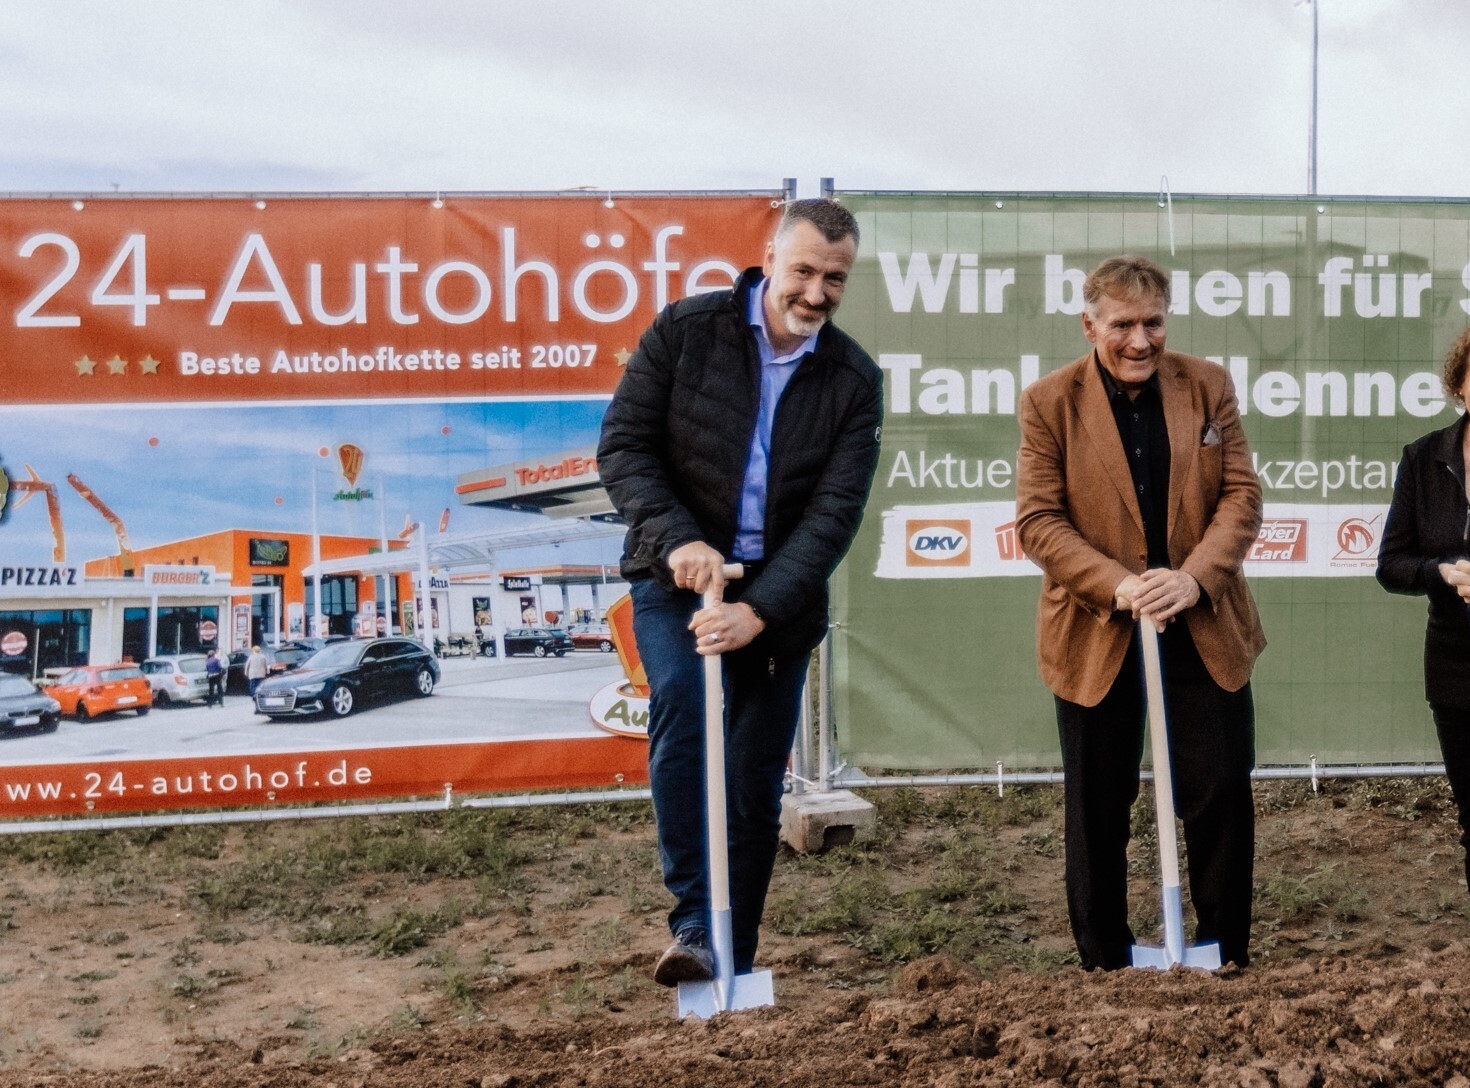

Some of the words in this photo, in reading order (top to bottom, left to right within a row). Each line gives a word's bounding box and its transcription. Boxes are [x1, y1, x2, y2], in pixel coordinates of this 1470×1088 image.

[15, 226, 740, 328] 24-Autohöfe
[878, 252, 1015, 313] Wir
[1318, 255, 1432, 318] für
[181, 352, 261, 376] Beste
[272, 346, 461, 374] Autohofkette
[471, 346, 521, 369] seit
[532, 344, 598, 368] 2007
[514, 456, 598, 486] TotalEn
[887, 450, 1018, 489] Aktue
[914, 536, 964, 551] DKV
[1258, 525, 1295, 543] oyer
[1250, 543, 1295, 560] Card
[603, 698, 650, 728] Au
